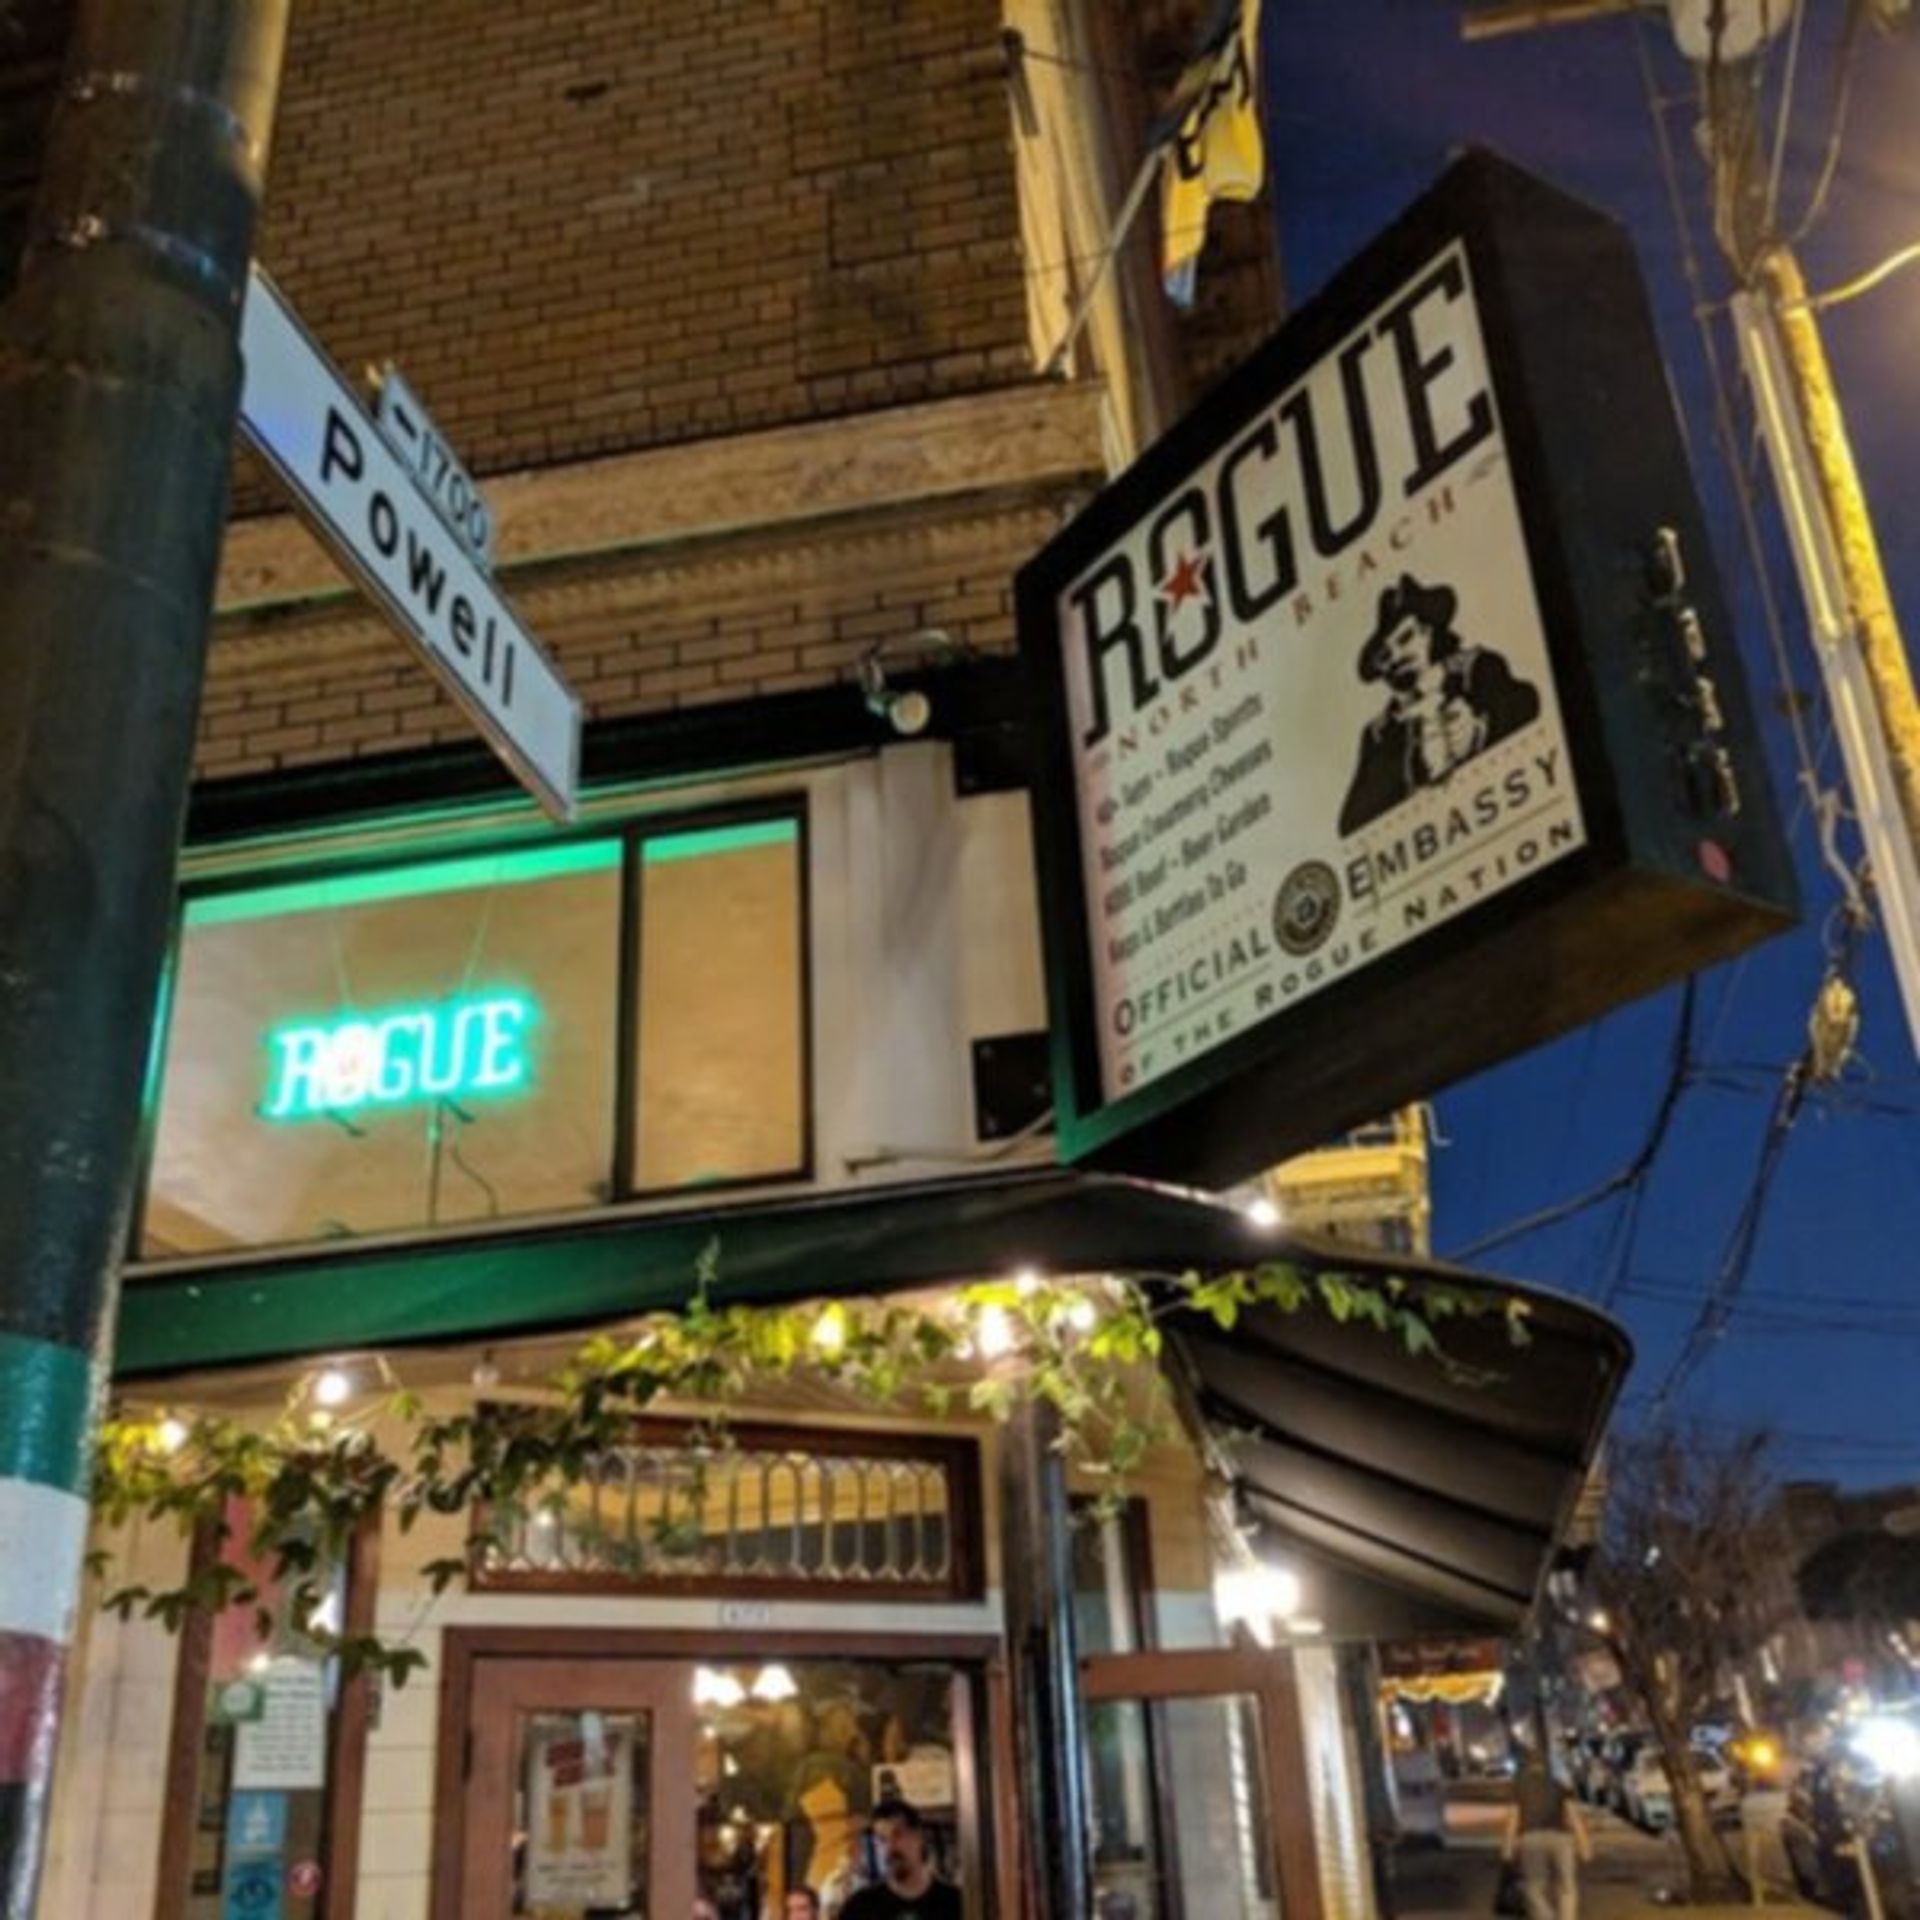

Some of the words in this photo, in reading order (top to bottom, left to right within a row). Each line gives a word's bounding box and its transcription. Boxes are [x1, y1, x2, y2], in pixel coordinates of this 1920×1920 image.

[320, 404, 514, 707] Powell
[420, 429, 488, 548] 1700
[1068, 252, 1496, 750] ROGUE
[1115, 636, 1260, 758] NORTH
[1291, 484, 1456, 626] BEACH
[1113, 926, 1270, 1038] OFFICIAL
[1345, 748, 1557, 901] EMBASSY
[1119, 1054, 1152, 1085] OF
[1174, 1008, 1233, 1054] THE
[1254, 926, 1378, 1010] ROGUE
[1402, 818, 1575, 928] NATION
[265, 998, 525, 1117] ROGUE
